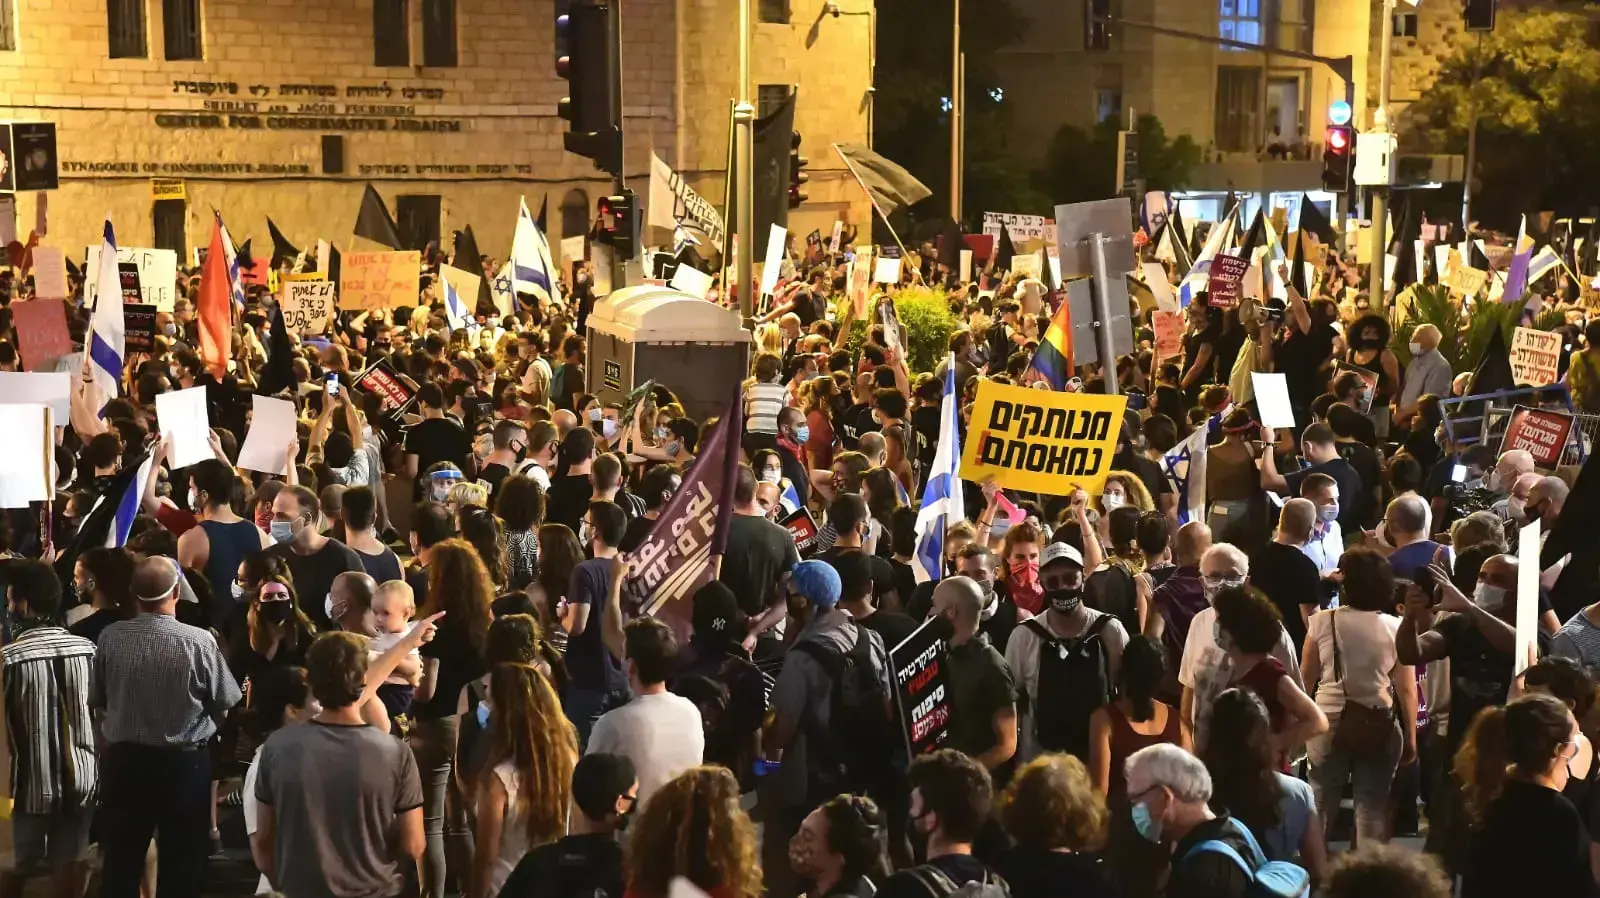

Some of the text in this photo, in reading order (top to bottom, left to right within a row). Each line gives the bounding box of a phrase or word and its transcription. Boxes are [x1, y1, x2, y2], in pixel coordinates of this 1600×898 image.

[154, 114, 460, 132] CENTER FOR CONSERVATIVE JUDAISM
[203, 100, 415, 116] SHIRLEY AND JACOB FUCHSBERG
[62, 161, 310, 174] SYNAGOGUE OF CONSERVATIVE JUDAISM
[988, 400, 1113, 441] מנותקים
[1518, 421, 1558, 445] סגרתם?
[974, 430, 1104, 477] נמאסתם!
[898, 638, 942, 685] דמוקרטיה
[911, 683, 945, 722] סיפוח
[914, 704, 949, 740] אף פעם!
